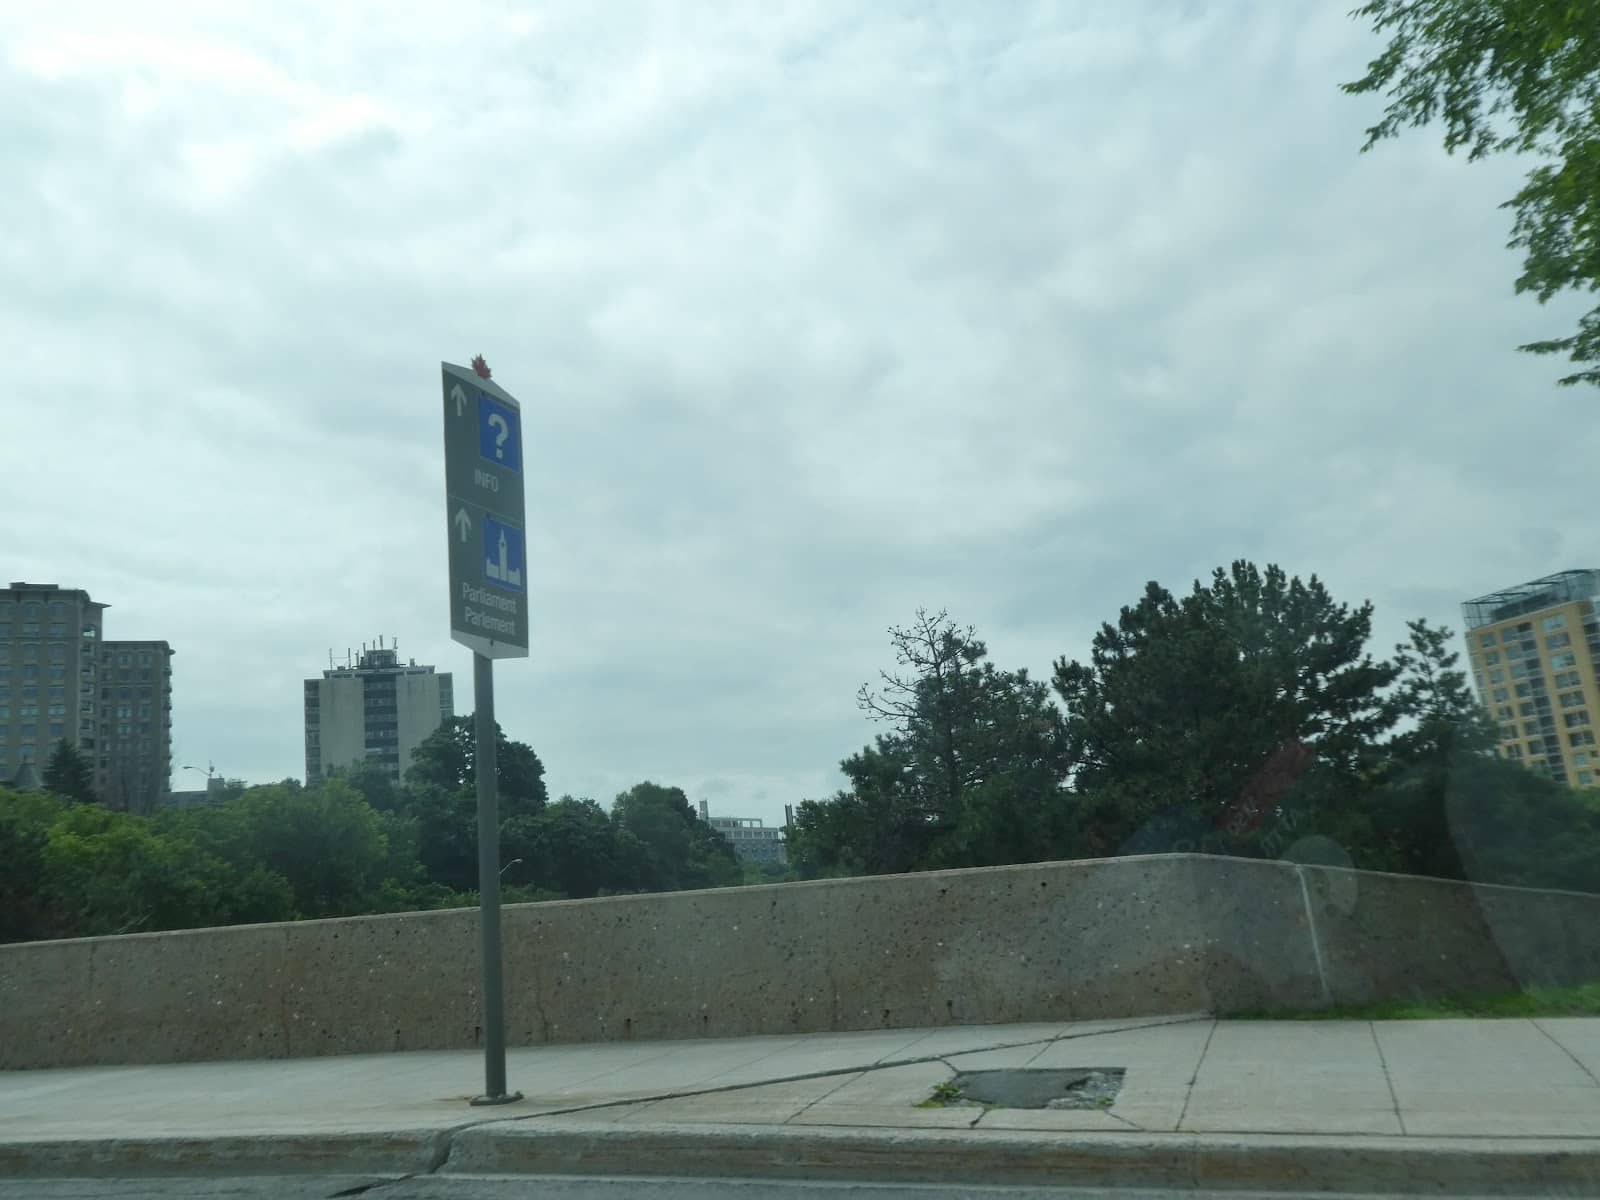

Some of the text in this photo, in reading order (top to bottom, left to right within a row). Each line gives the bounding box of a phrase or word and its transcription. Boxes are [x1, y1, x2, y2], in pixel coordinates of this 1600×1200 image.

[474, 469, 499, 492] INFO
[462, 582, 516, 614] Parliament
[465, 606, 515, 636] Parlement
